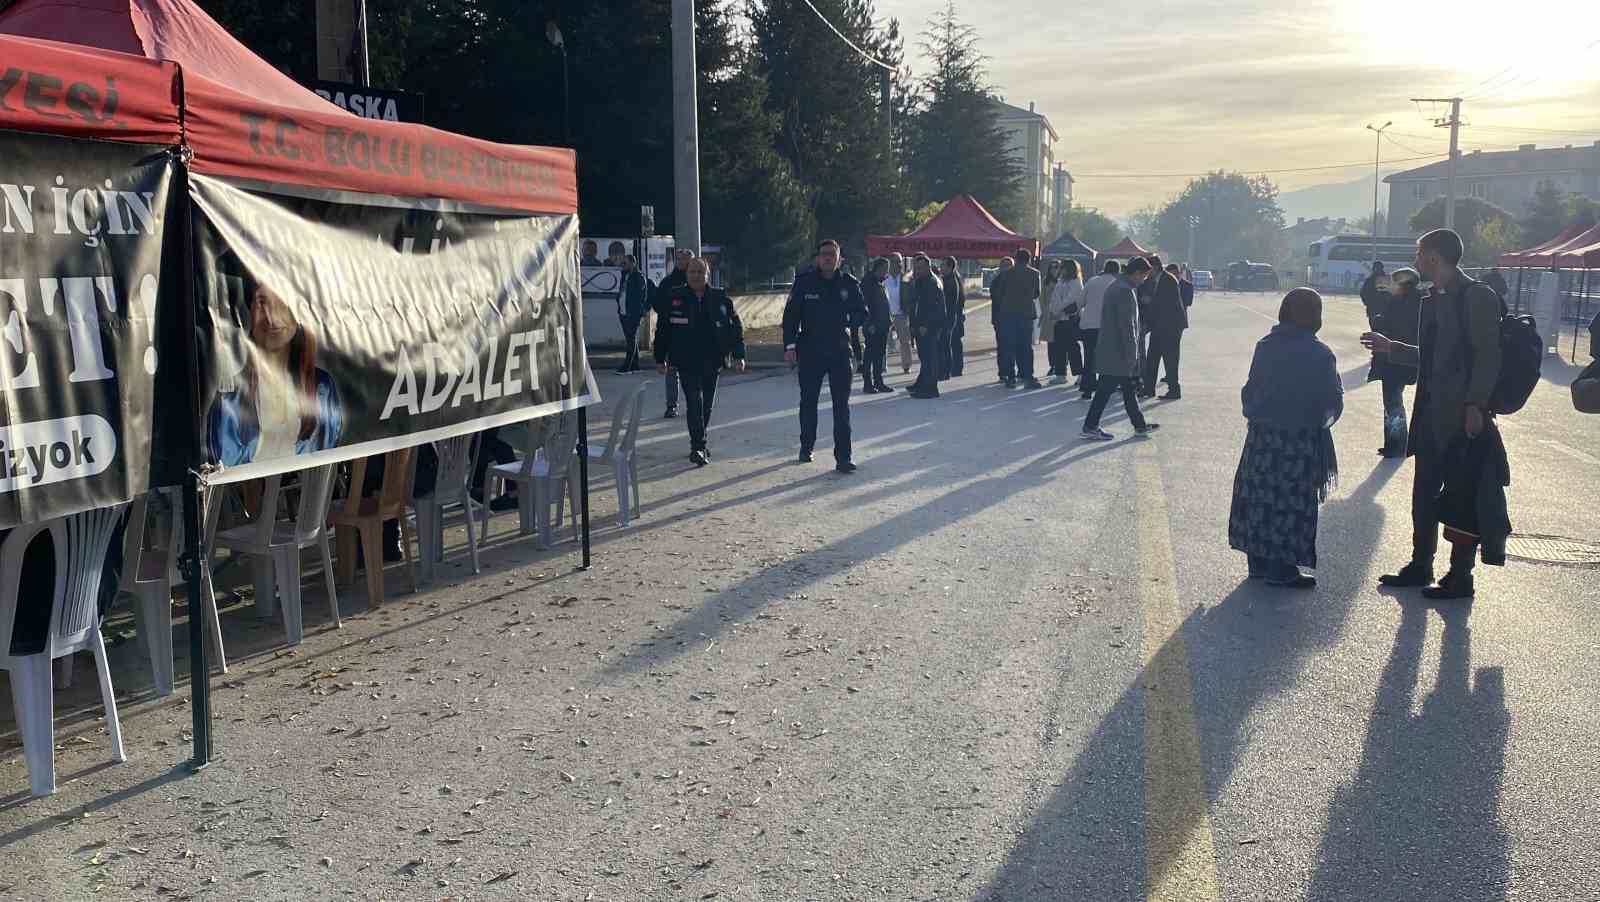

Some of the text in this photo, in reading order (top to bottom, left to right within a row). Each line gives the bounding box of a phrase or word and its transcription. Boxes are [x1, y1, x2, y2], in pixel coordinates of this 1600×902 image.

[324, 126, 412, 177] BOLU
[52, 175, 155, 248] İÇİN
[379, 328, 546, 420] ADALET
